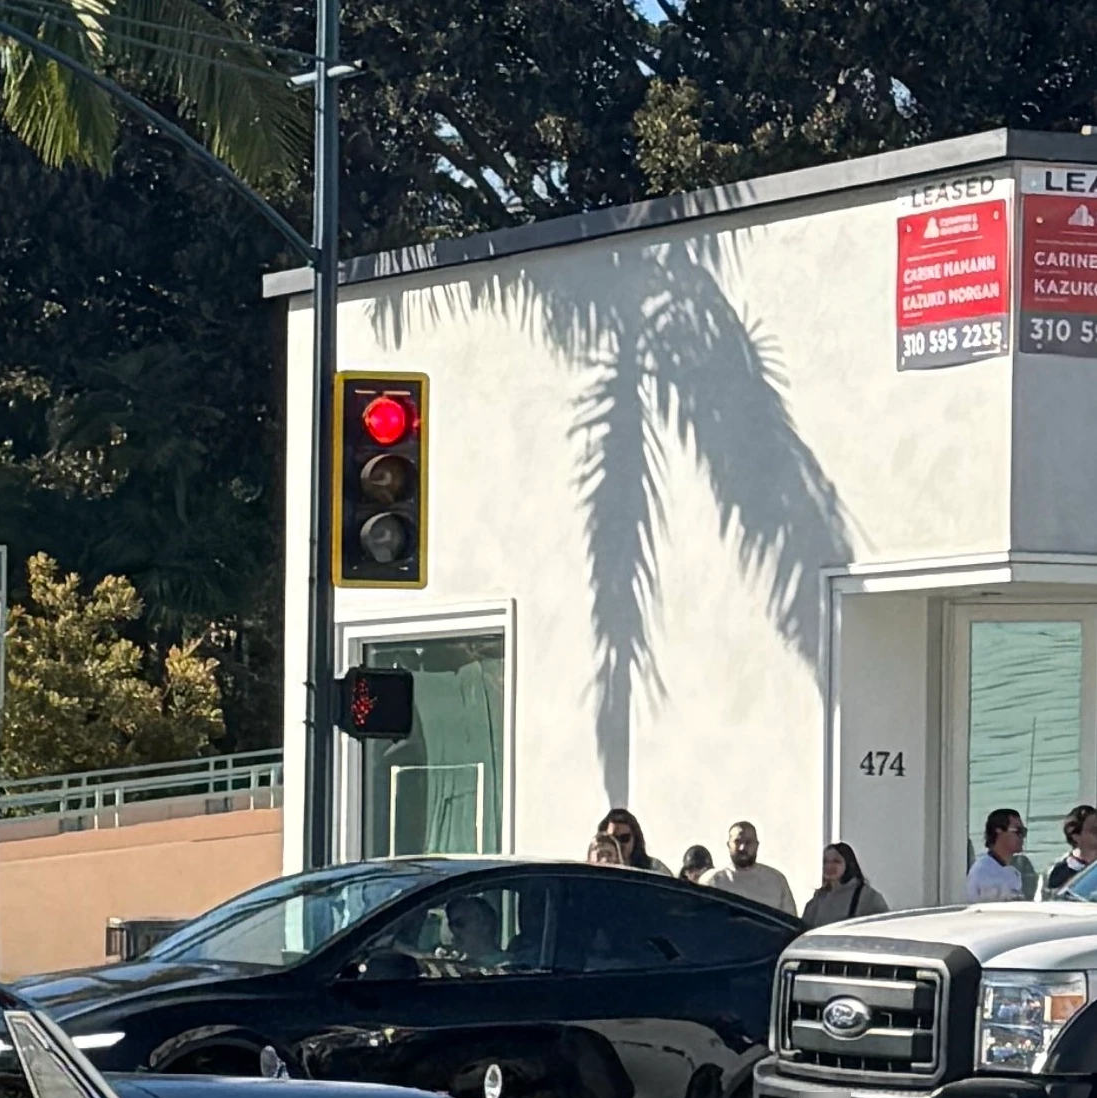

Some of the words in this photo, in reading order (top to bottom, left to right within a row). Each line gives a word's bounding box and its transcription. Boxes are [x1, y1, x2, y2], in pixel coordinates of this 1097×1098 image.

[912, 175, 995, 208] LEASED
[903, 290, 947, 311] KAZUKO
[903, 331, 925, 357] 310
[929, 327, 957, 353] 595
[962, 321, 1002, 348] 2235
[1030, 318, 1071, 342] 310
[1080, 321, 1097, 343] 5
[859, 751, 906, 777] 474
